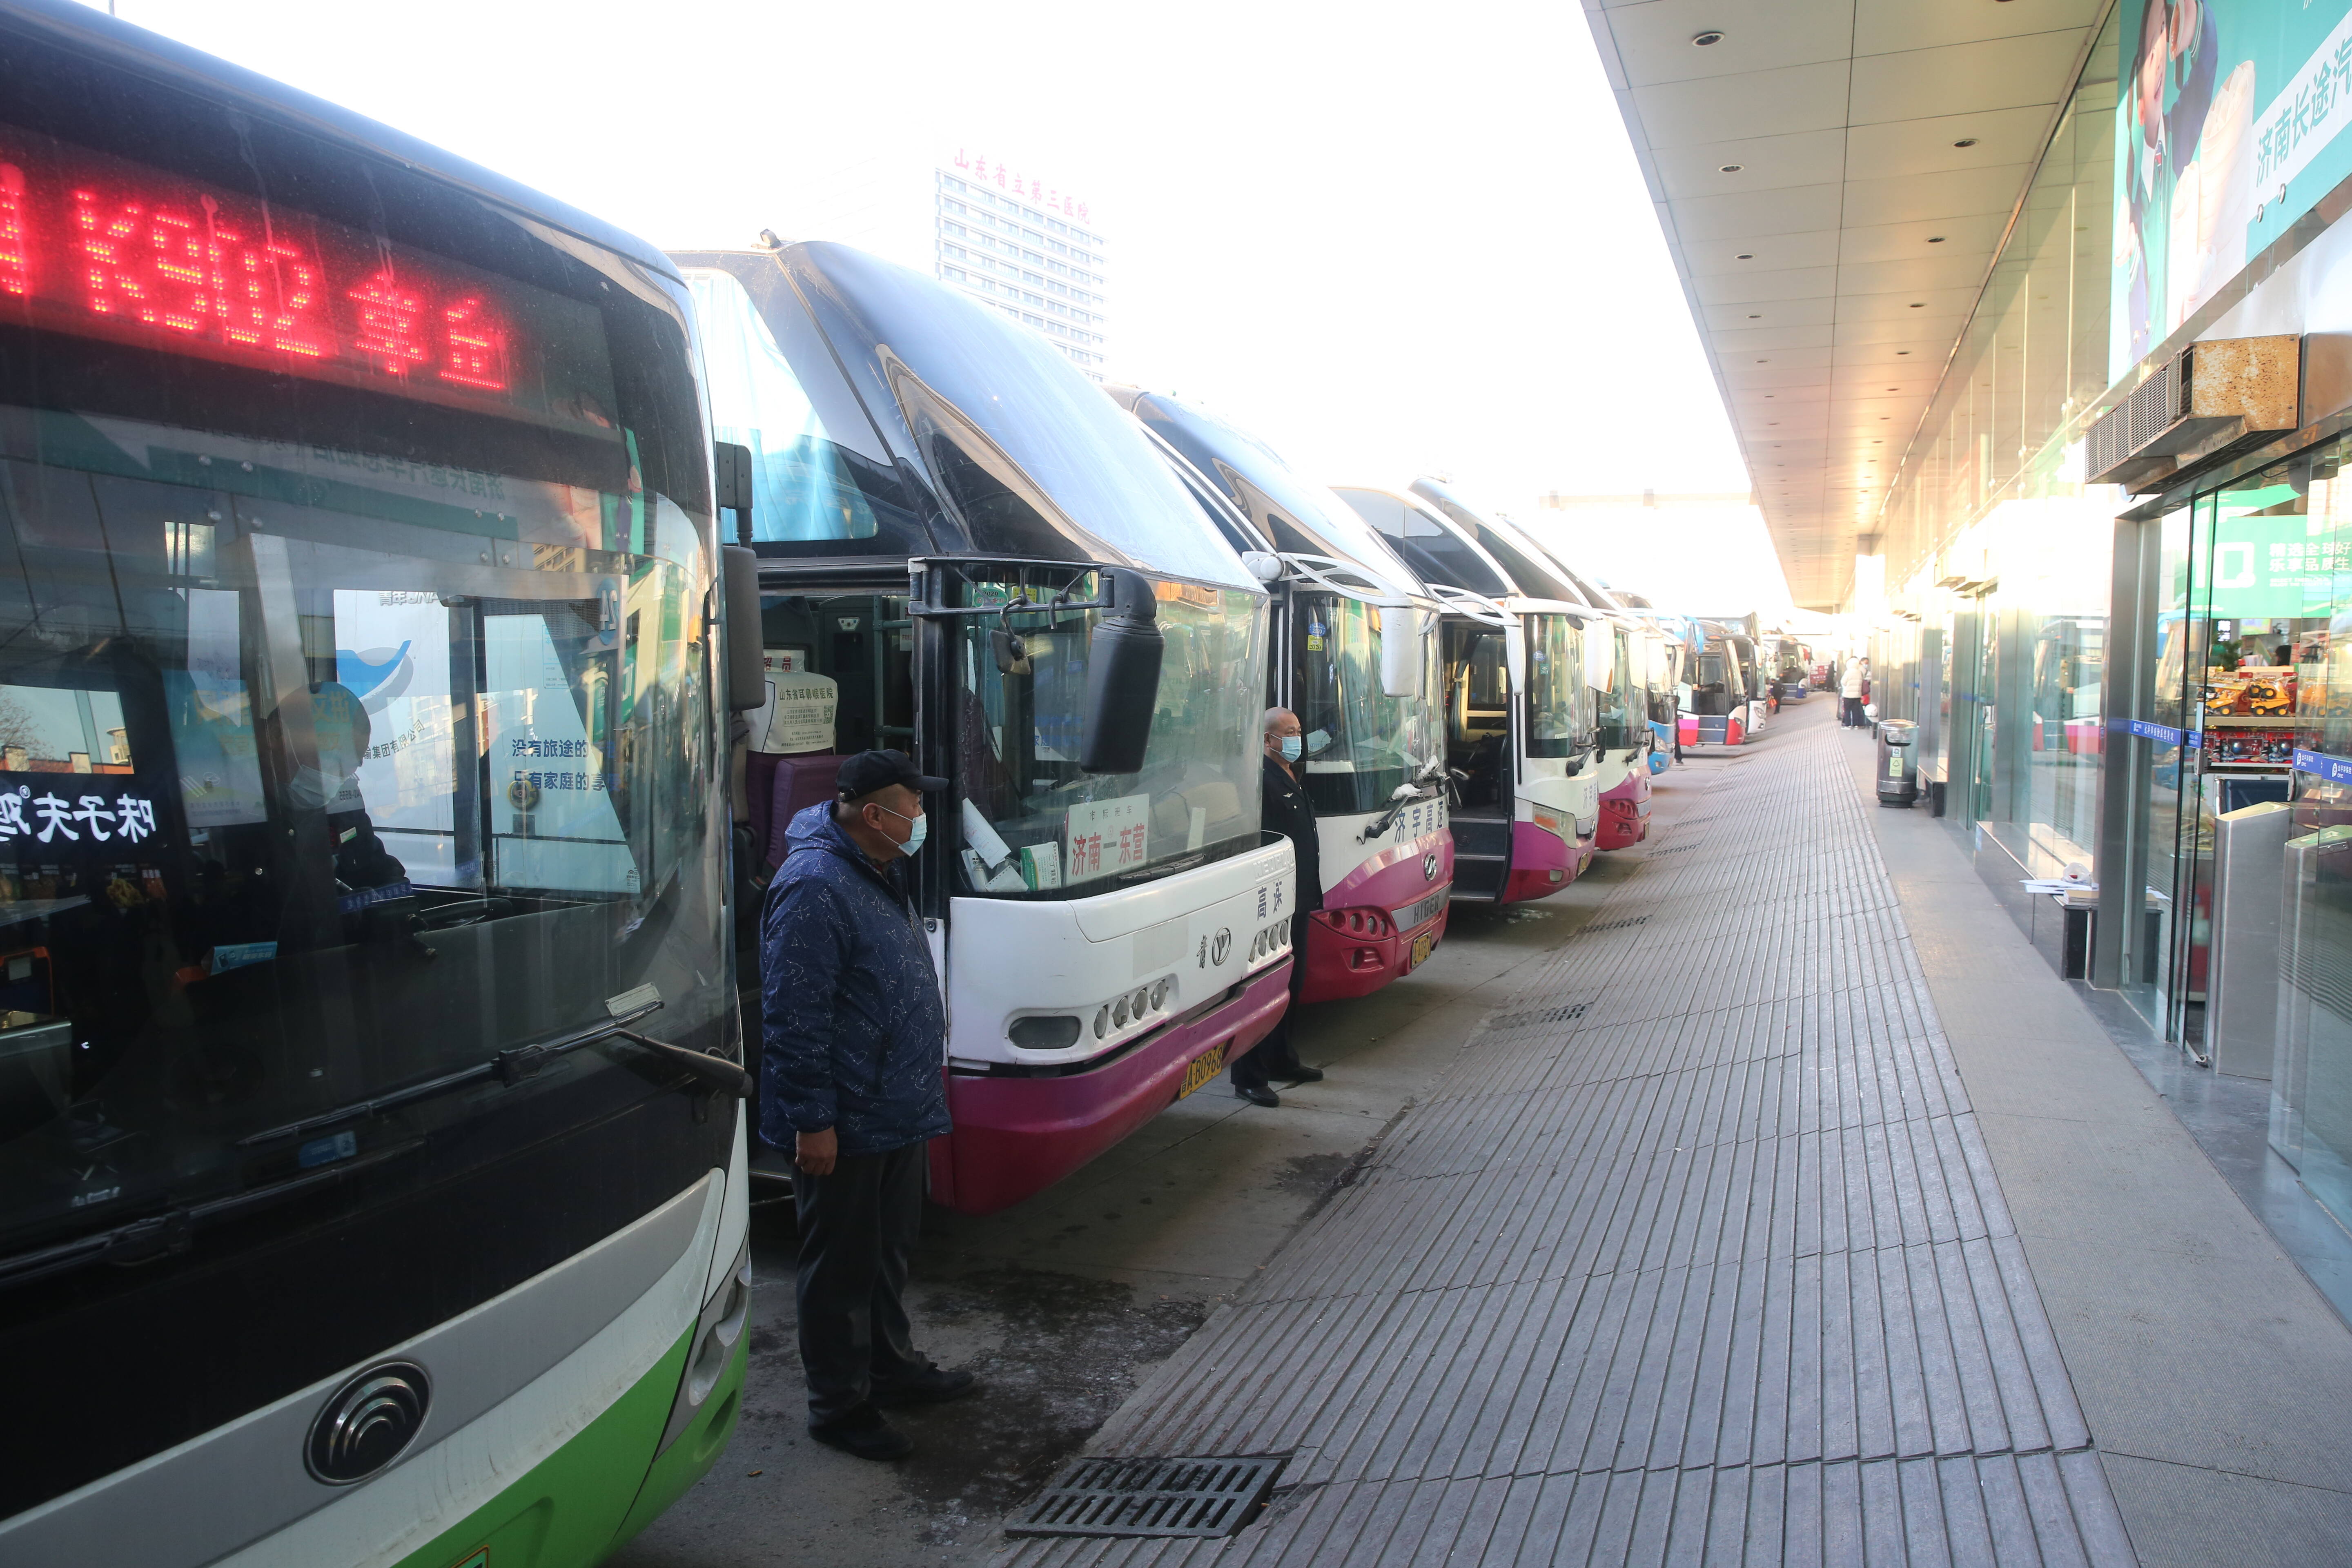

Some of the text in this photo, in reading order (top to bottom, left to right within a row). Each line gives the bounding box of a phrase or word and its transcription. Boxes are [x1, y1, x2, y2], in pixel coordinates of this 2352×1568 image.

[954, 148, 1090, 225] 山东省立第三医院
[77, 193, 318, 356] K902
[2269, 542, 2352, 557] 精选全球好
[2269, 557, 2351, 572] 乐享品质生
[779, 687, 834, 701] 山东省耳鼻喉医院
[1089, 805, 1132, 821] 市际班车
[1394, 799, 1444, 843] 济宇高速
[1257, 879, 1282, 921] 高速
[1413, 895, 1439, 924] HIGER
